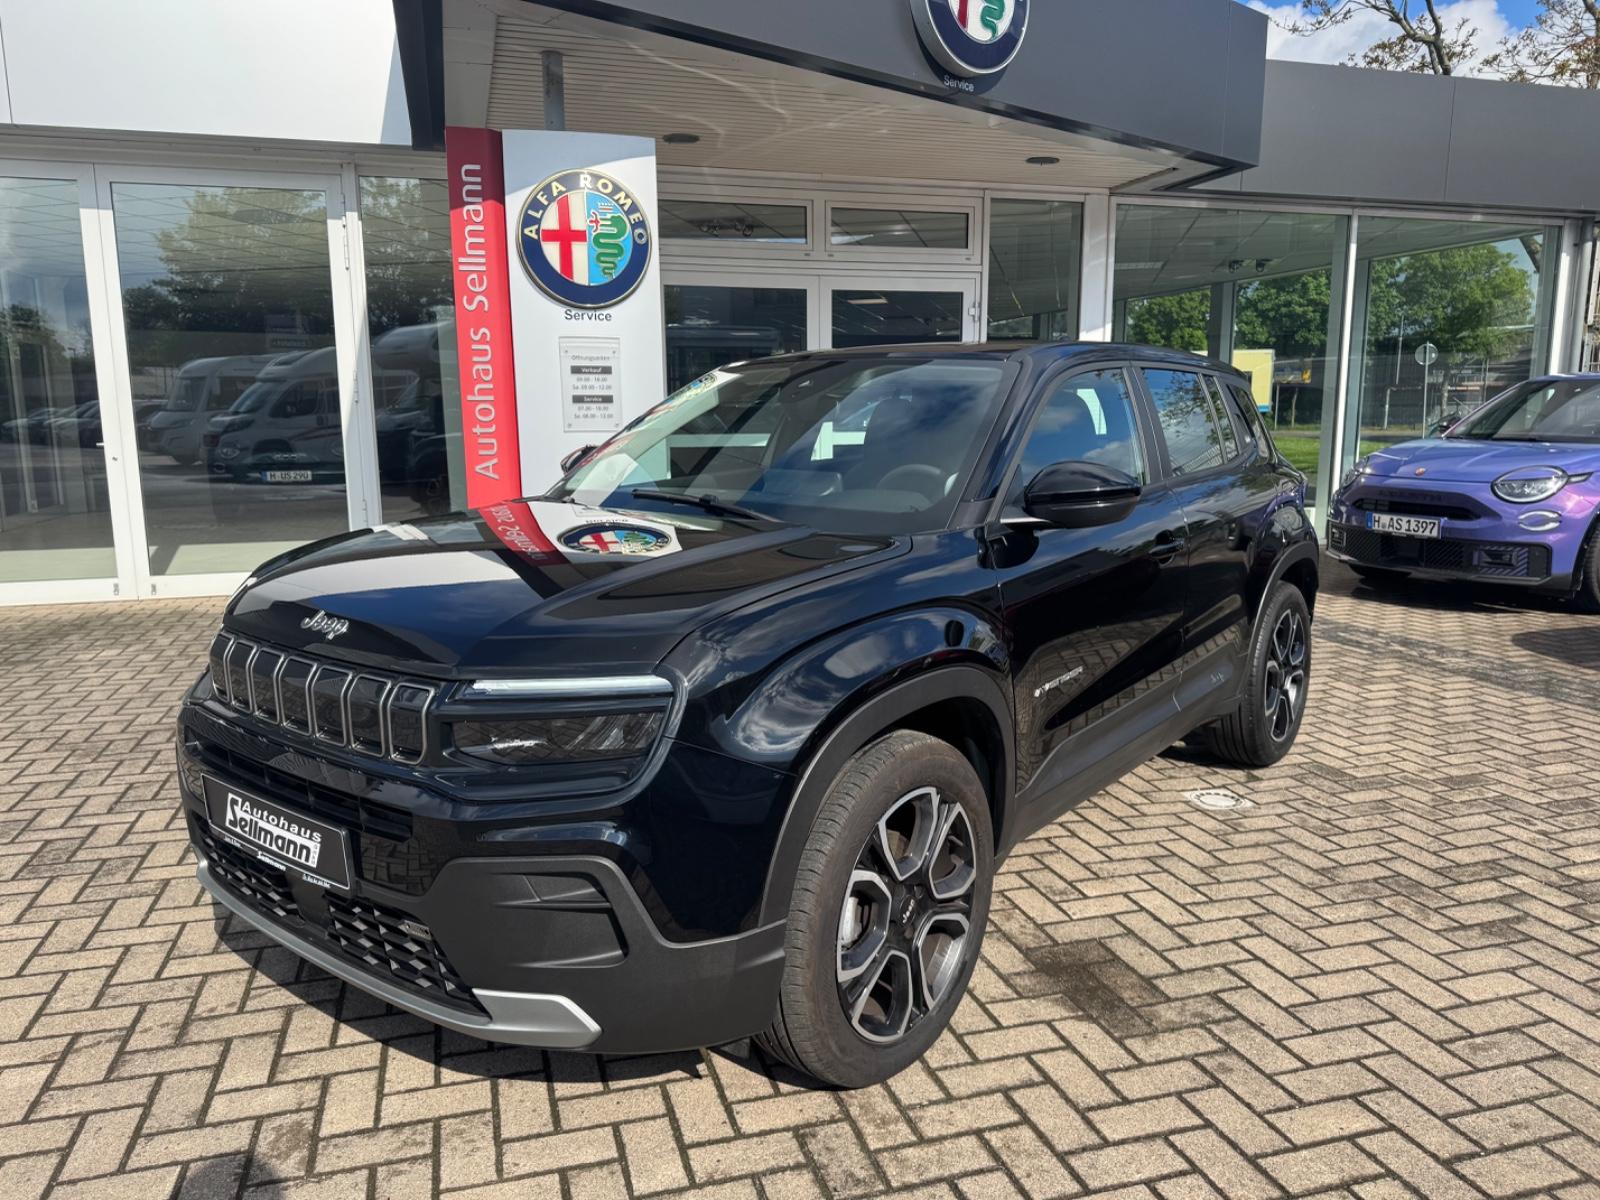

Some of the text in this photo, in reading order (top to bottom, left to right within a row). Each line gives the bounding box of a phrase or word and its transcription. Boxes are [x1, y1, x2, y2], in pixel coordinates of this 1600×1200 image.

[944, 75, 975, 92] Service
[524, 174, 648, 245] ALFA ROMEO
[458, 163, 500, 480] Autohaus Sellmann
[564, 308, 613, 321] Service
[1373, 515, 1381, 529] H
[1404, 519, 1437, 535] 1397
[301, 610, 349, 640] Jeep
[227, 795, 313, 864] Sellmann
[241, 801, 323, 843] Autohaus
